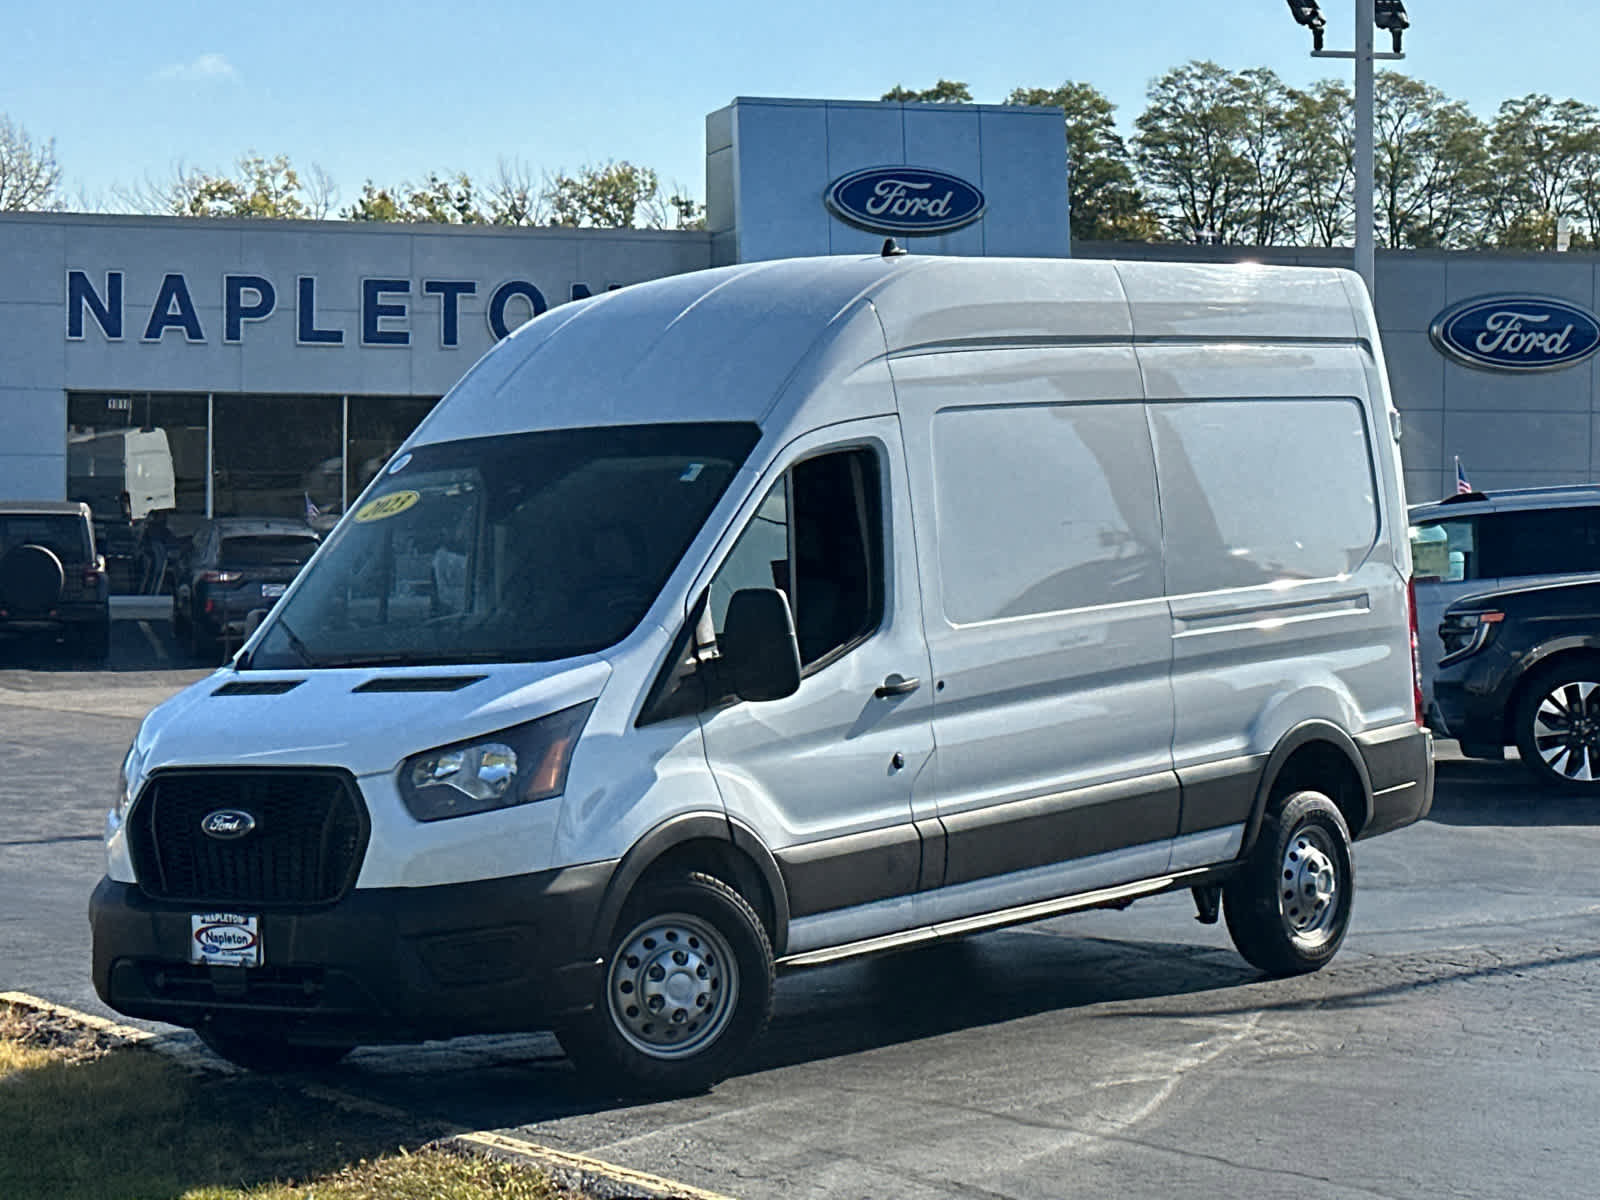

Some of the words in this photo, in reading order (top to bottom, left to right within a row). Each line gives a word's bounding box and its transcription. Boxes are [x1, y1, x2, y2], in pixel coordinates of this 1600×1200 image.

[866, 179, 953, 217] Ford
[65, 269, 624, 349] NAPLETO
[1475, 311, 1574, 355] Ford
[209, 815, 240, 831] Ford
[205, 931, 249, 946] Napleton
